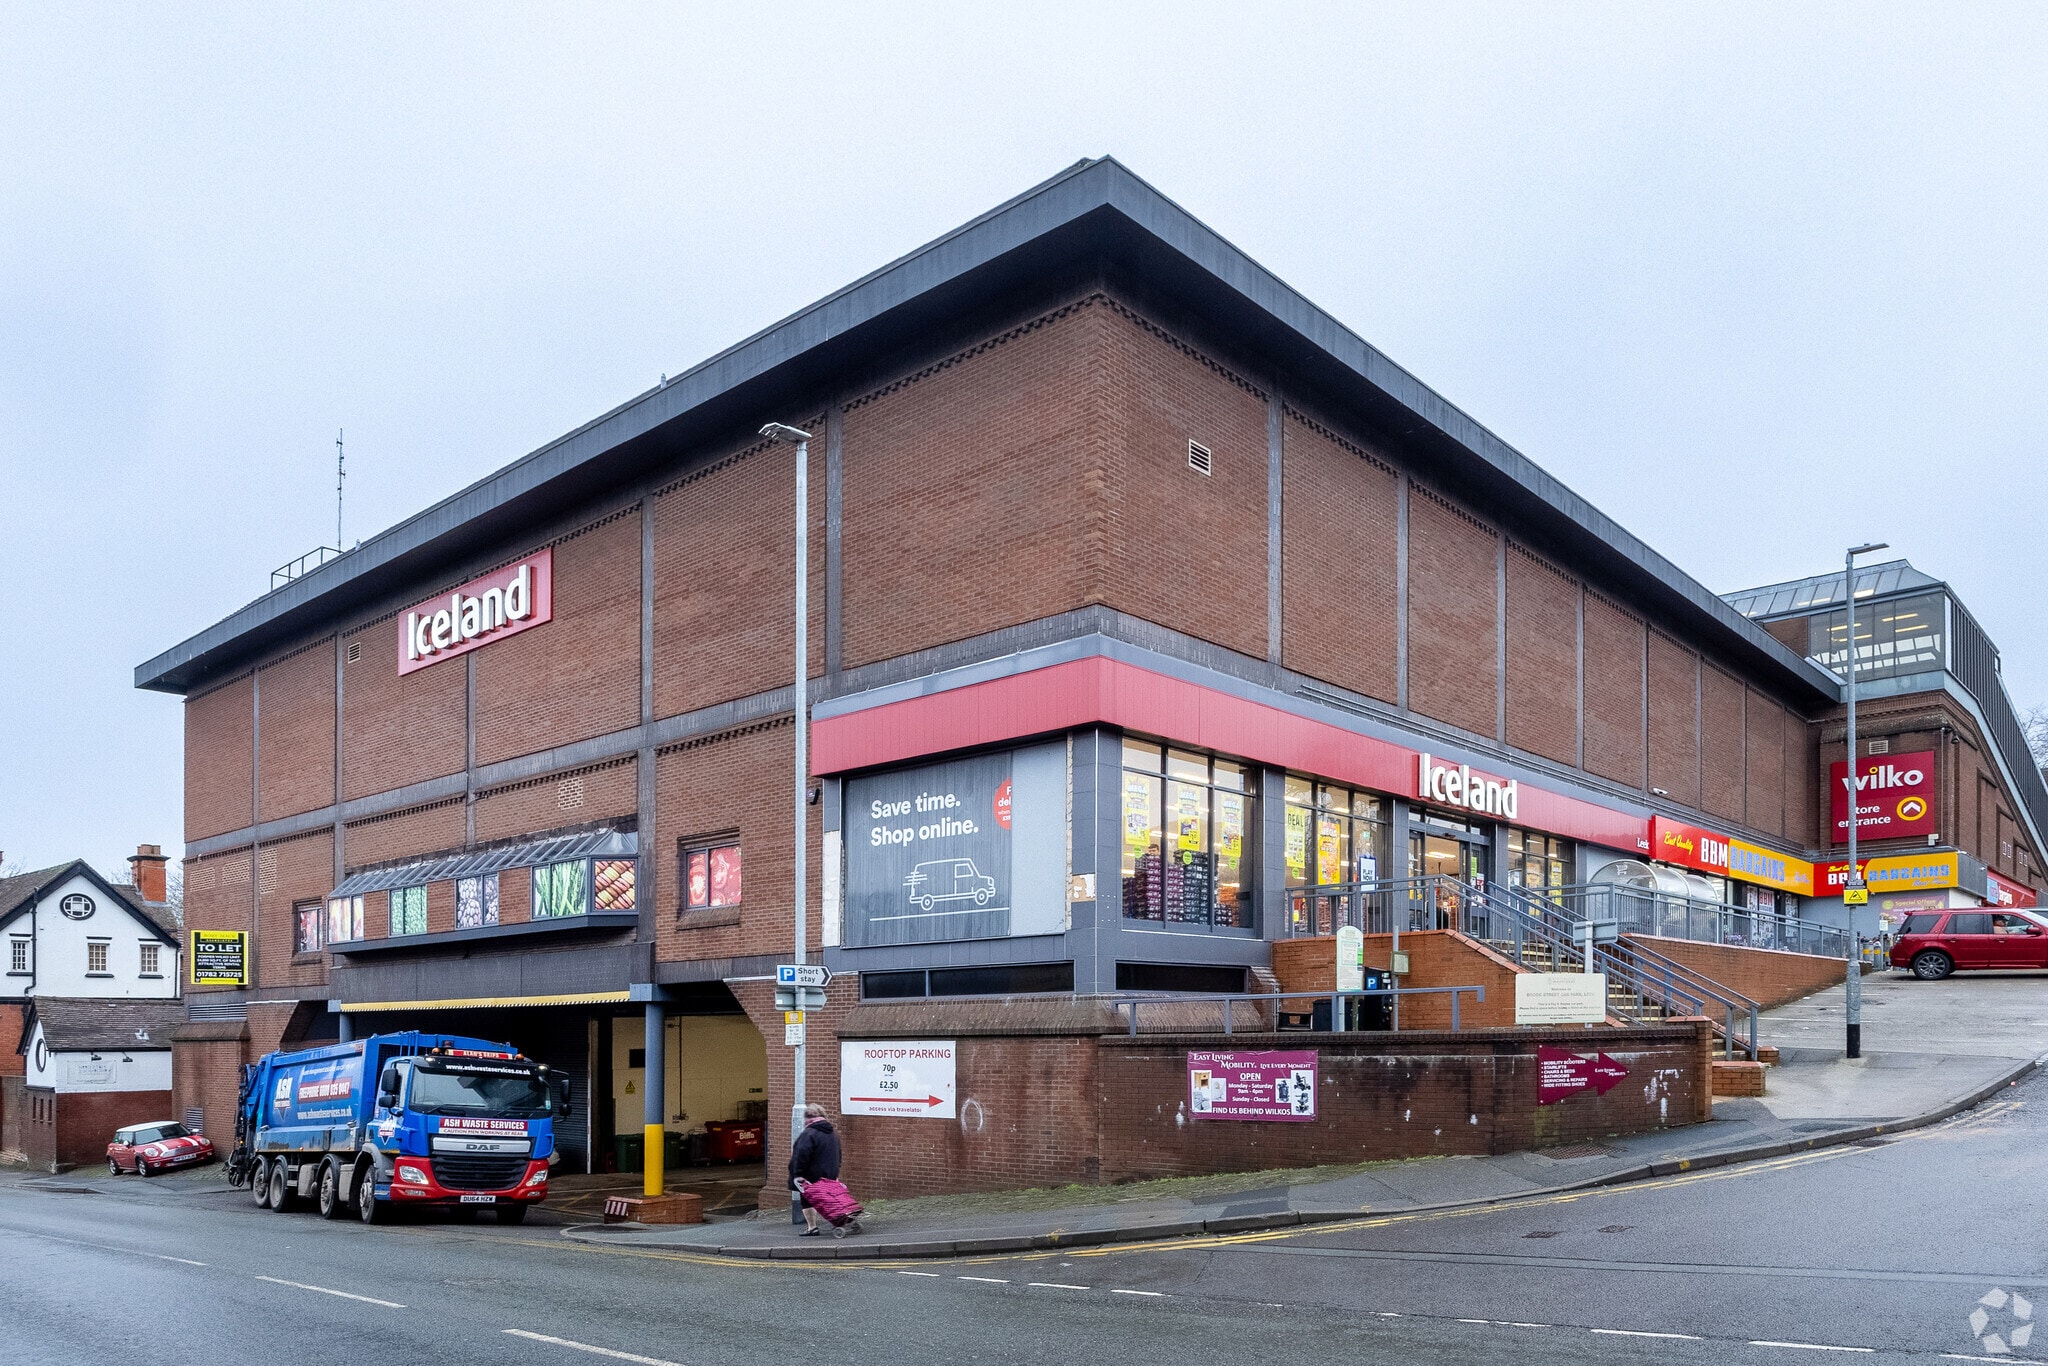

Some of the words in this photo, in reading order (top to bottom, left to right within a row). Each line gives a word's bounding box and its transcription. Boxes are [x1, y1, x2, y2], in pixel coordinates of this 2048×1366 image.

[408, 564, 531, 660] Iceland
[1419, 752, 1518, 819] Iceland
[1842, 765, 1924, 791] wilko
[871, 800, 911, 818] Save
[915, 792, 960, 812] time.
[1856, 806, 1880, 814] tore
[1288, 814, 1303, 828] DEAL
[870, 826, 914, 847] Shop
[919, 816, 979, 840] online.
[1637, 837, 1649, 850] Leek
[1664, 831, 1676, 845] Best
[1676, 835, 1694, 855] Quality
[1701, 837, 1728, 868] BBM
[1730, 846, 1785, 882] BARGAINS
[1869, 865, 1949, 881] BARGAINS
[784, 969, 793, 980] P
[1368, 978, 1375, 988] P
[864, 1049, 906, 1058] ROOFTOP
[910, 1049, 951, 1058] PARKING
[883, 1064, 896, 1073] 70p
[275, 1077, 293, 1100] ASH
[444, 1119, 460, 1127] ASH
[462, 1119, 489, 1128] WASTE
[490, 1120, 524, 1129] SERVICES
